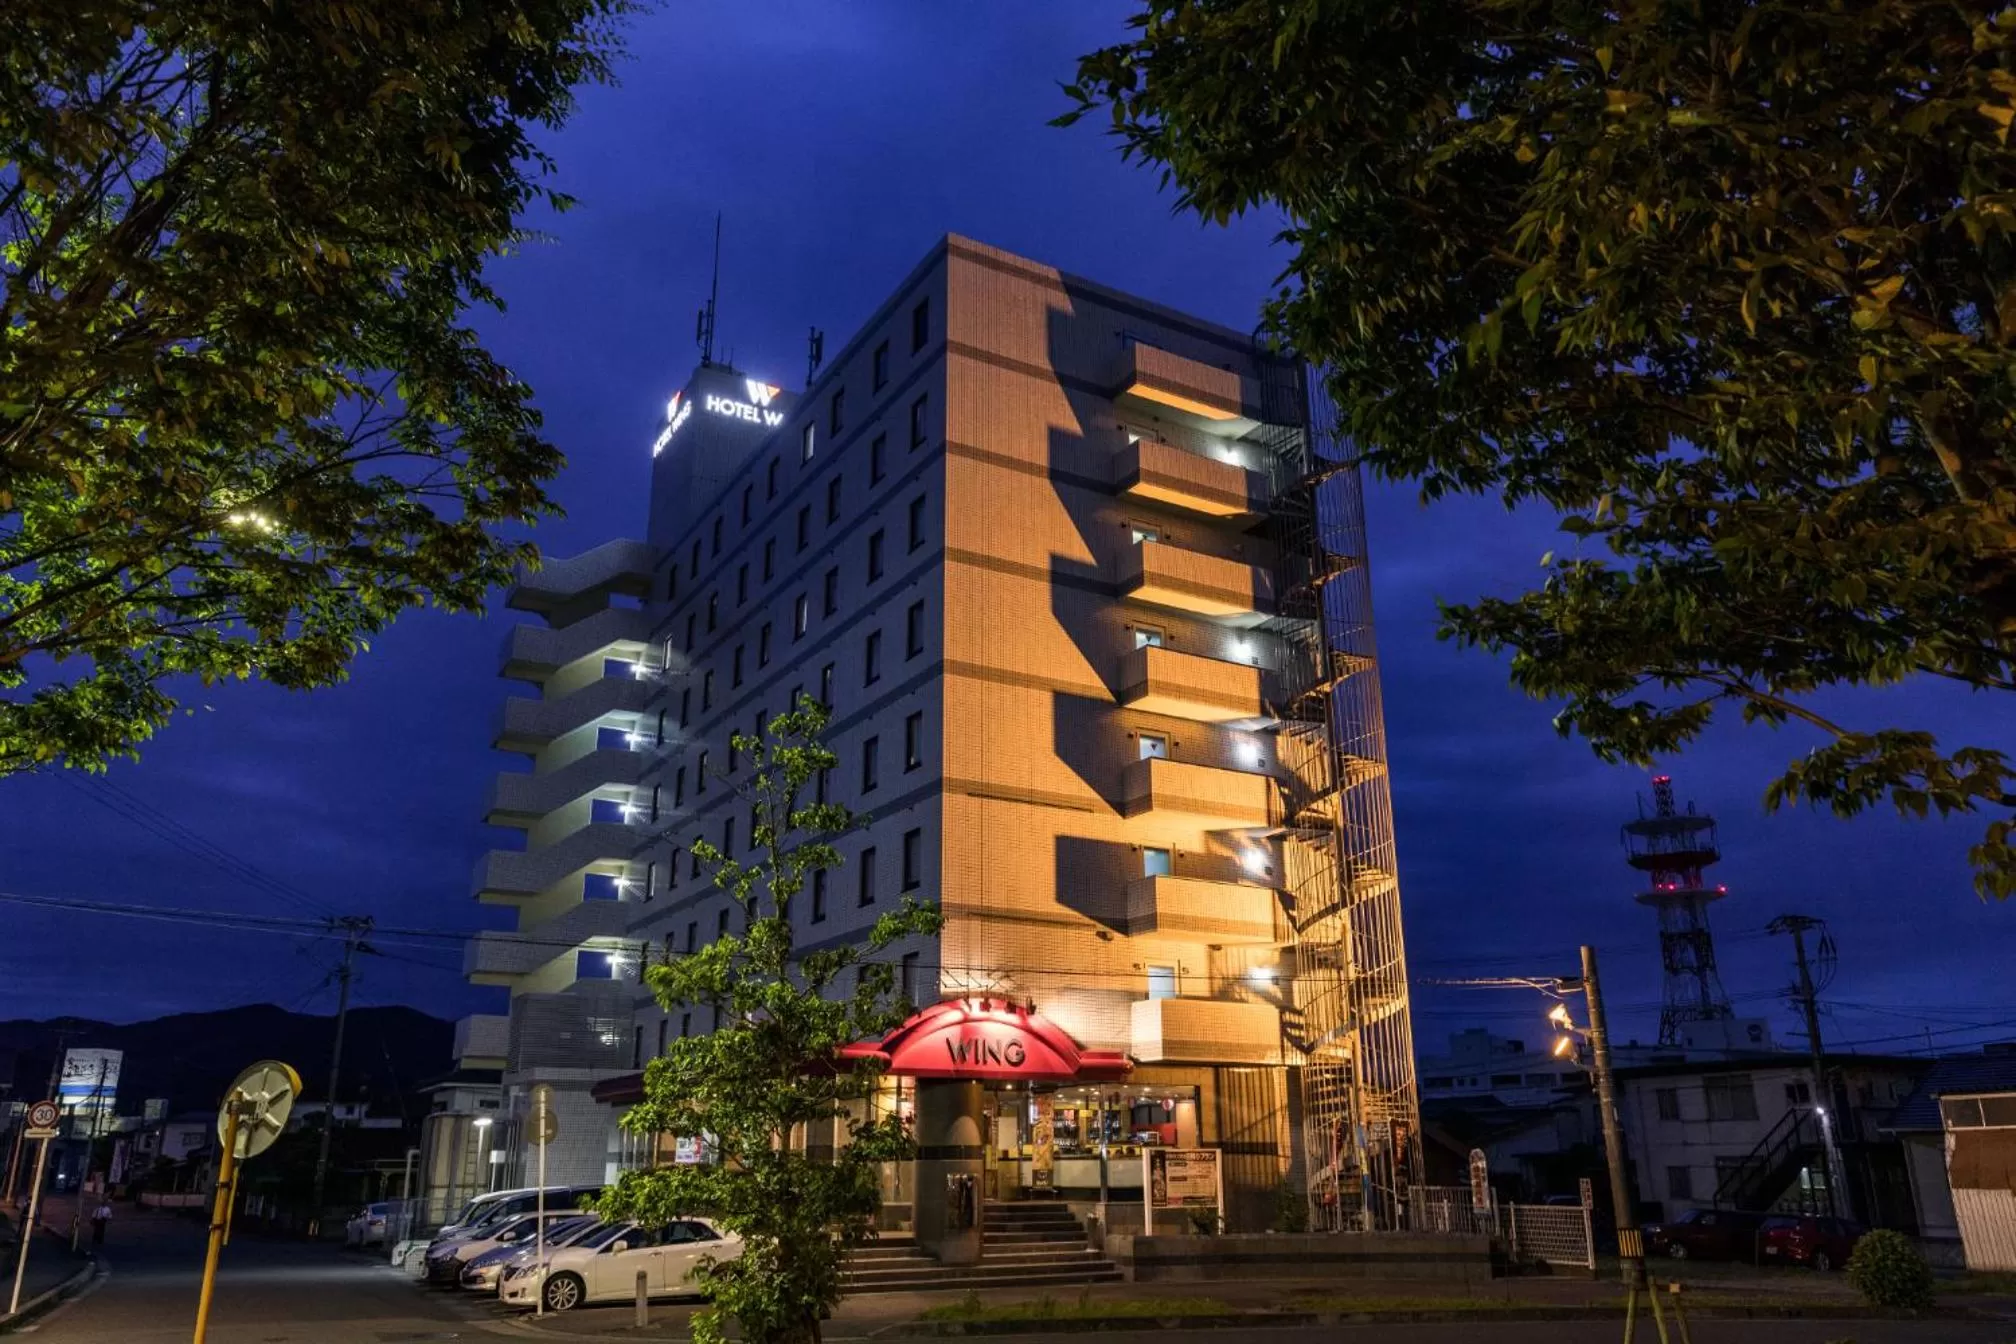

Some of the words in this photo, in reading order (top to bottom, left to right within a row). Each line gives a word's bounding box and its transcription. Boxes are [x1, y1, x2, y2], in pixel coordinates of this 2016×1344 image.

[707, 394, 762, 423] HOTEL
[946, 1037, 1026, 1068] WING
[36, 1108, 53, 1121] 30
